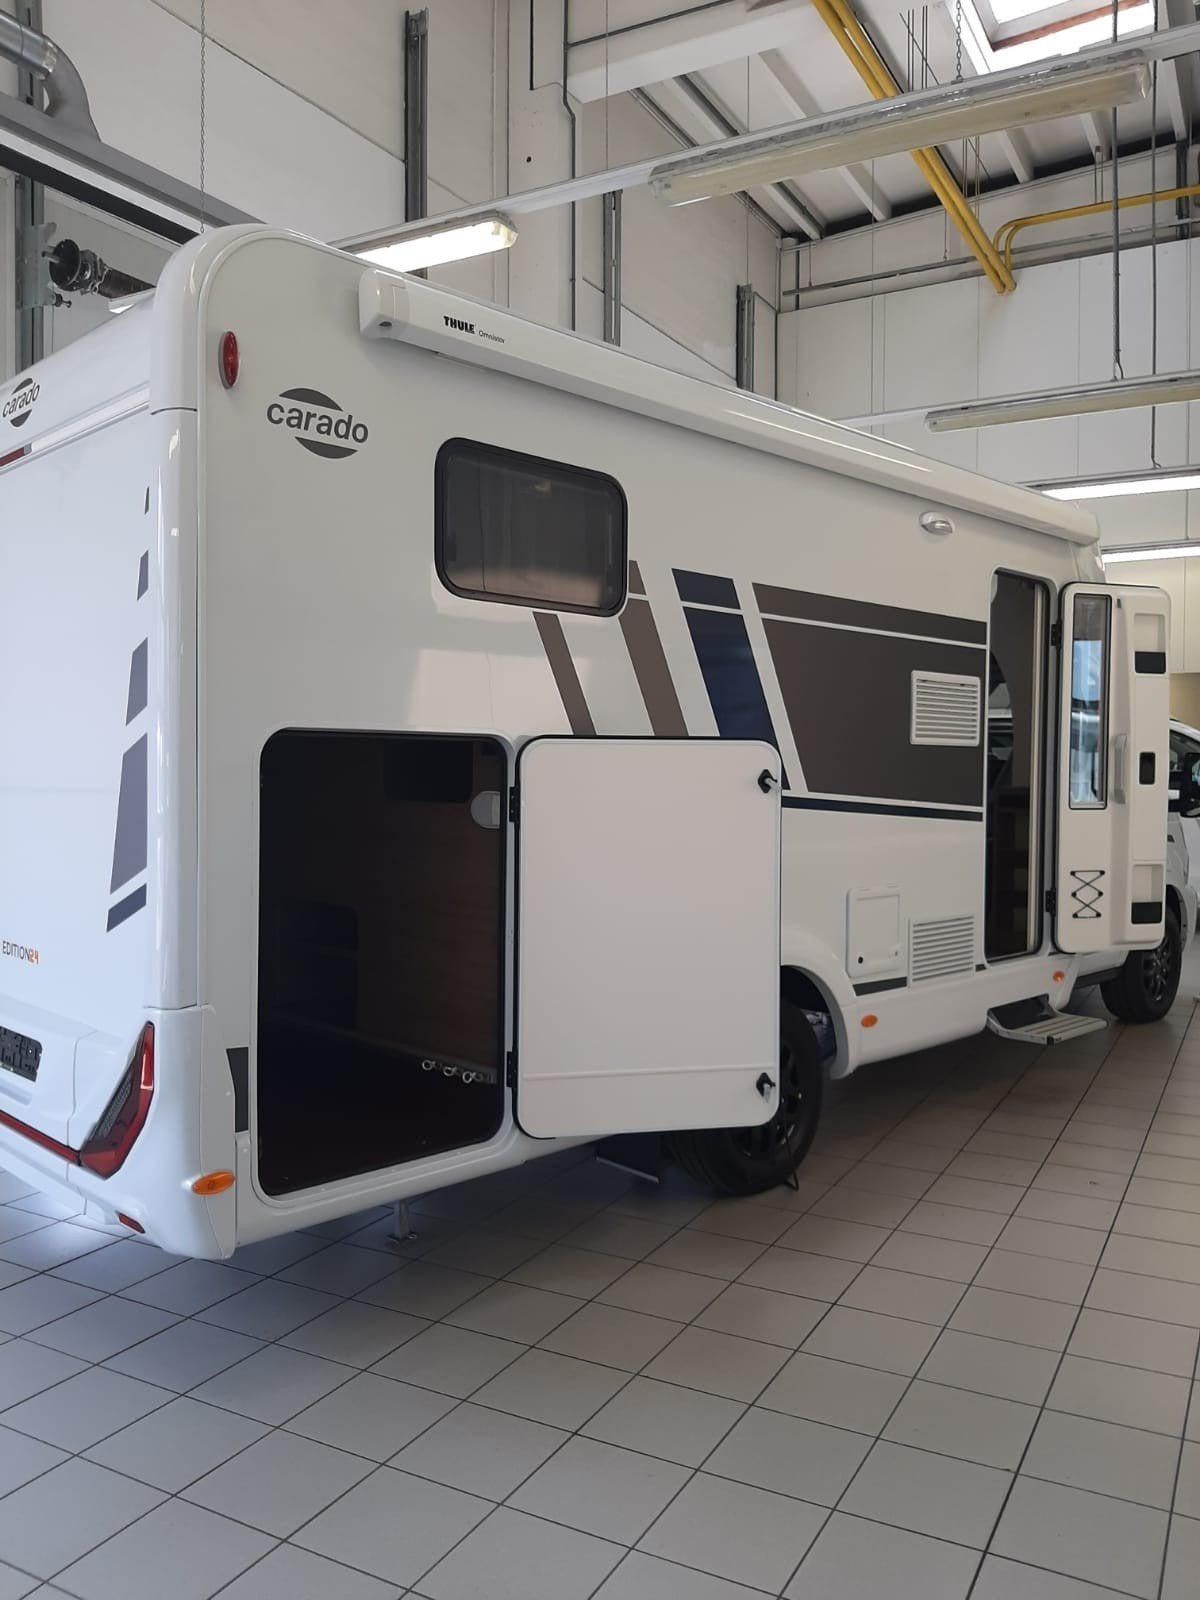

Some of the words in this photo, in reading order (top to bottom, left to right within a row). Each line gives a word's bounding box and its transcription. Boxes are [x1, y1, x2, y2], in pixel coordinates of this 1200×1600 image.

[443, 315, 475, 334] THULE
[2, 382, 40, 418] carado
[266, 403, 369, 443] carado
